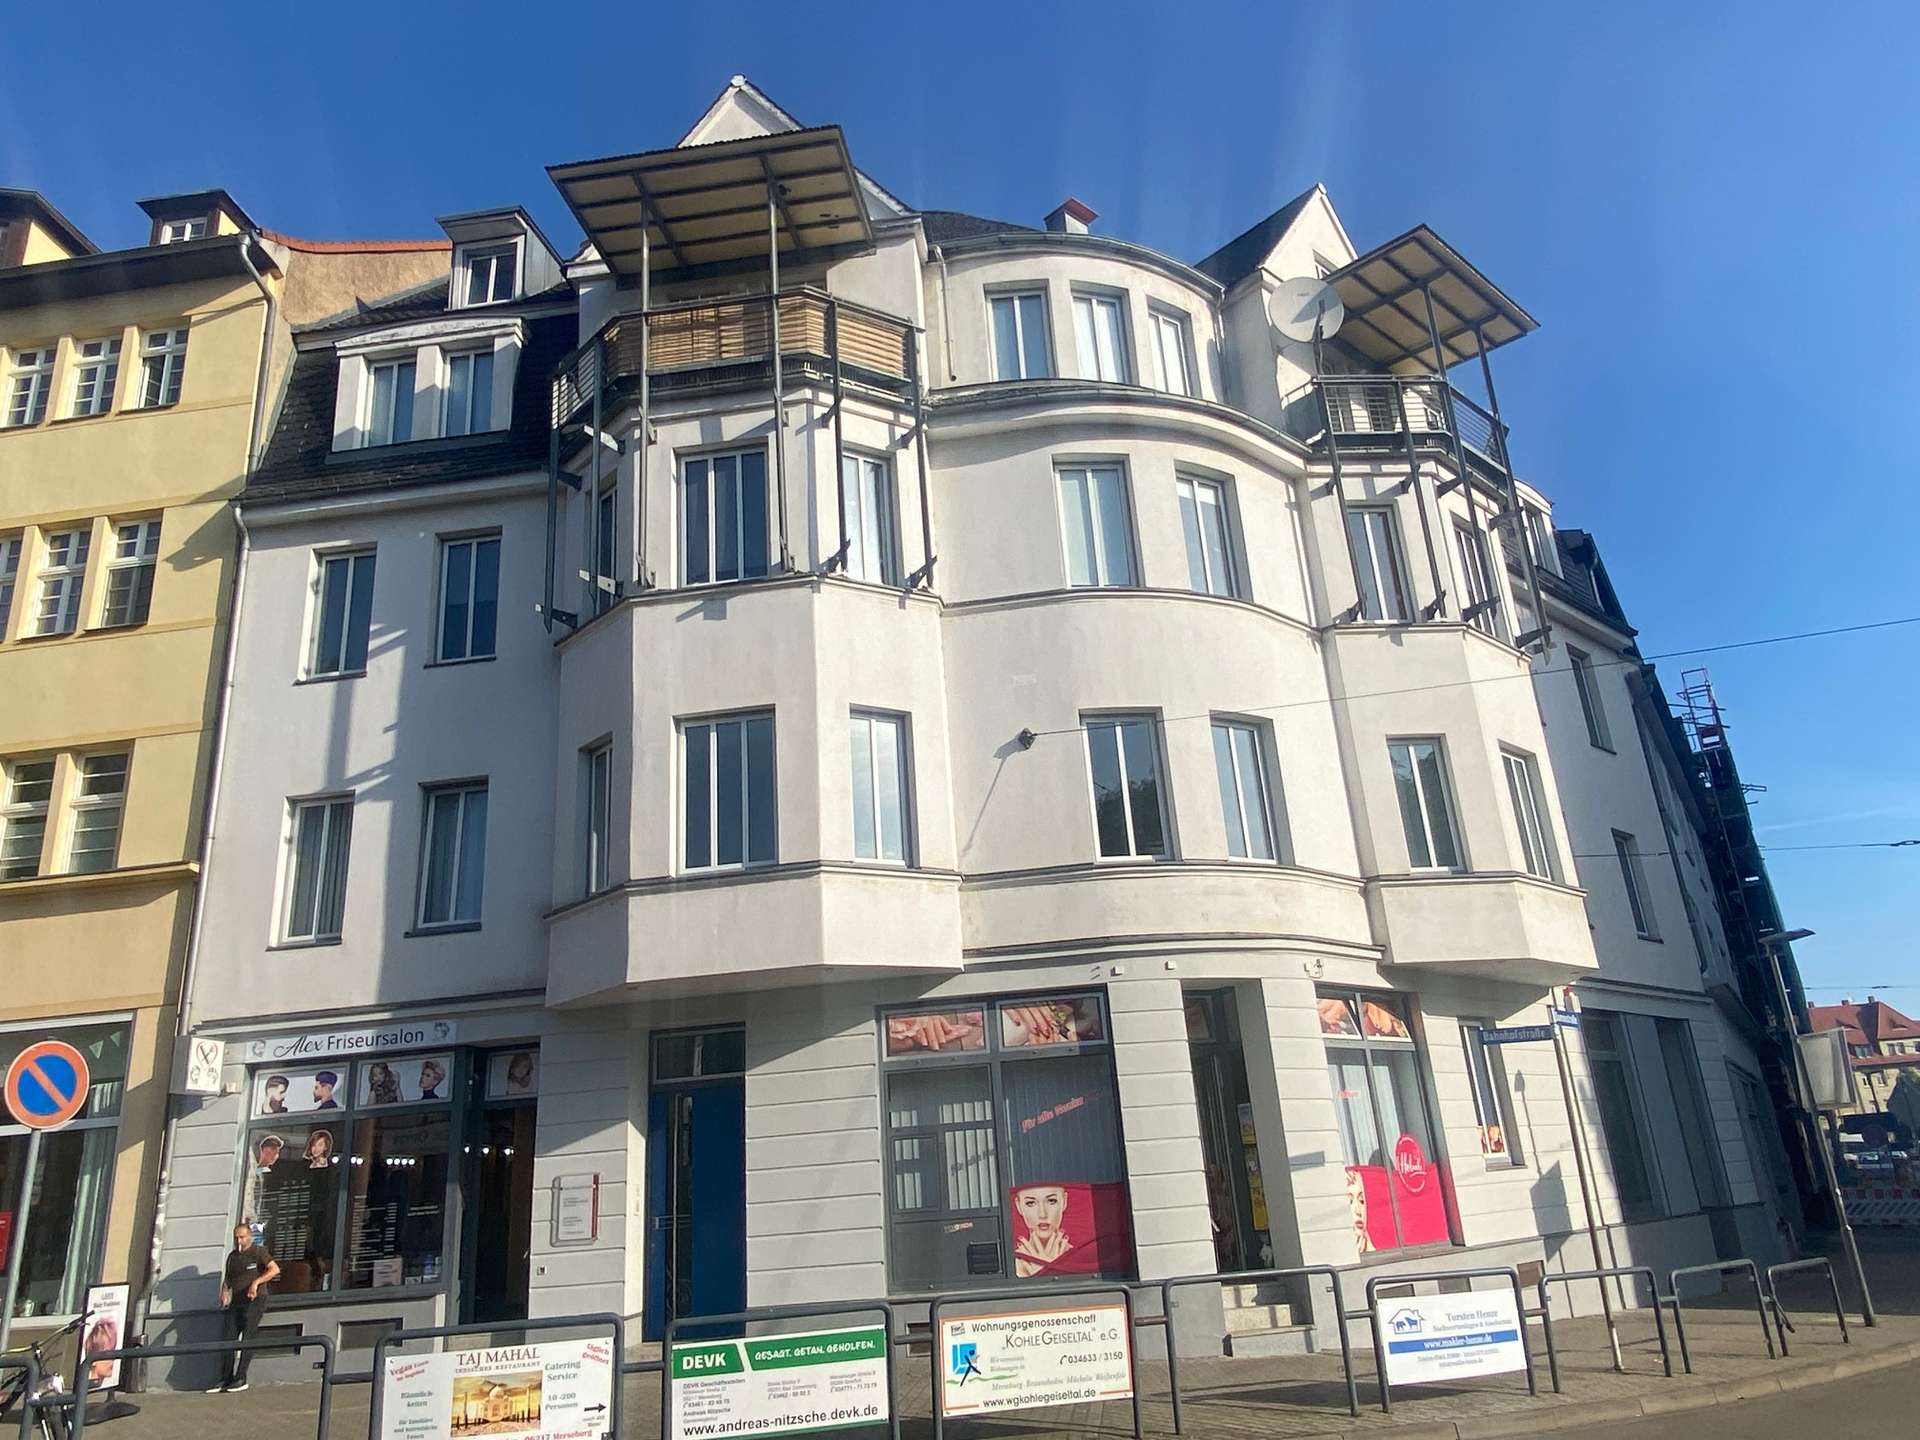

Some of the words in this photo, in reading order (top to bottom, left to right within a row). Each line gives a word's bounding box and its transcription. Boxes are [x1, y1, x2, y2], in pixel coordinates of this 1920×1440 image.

[1483, 1029, 1545, 1042] Bahnhofstraße
[273, 1035, 324, 1058] Alex
[327, 1029, 424, 1051] Friseursalon
[971, 1314, 1097, 1333] Wohnungsgenossenschaft
[1100, 1328, 1120, 1341] e.G.
[754, 1349, 792, 1361] GESAGT.
[794, 1346, 825, 1357] GETAN.
[827, 1340, 876, 1354] GEHOLFEN.
[456, 1351, 483, 1368] TAJ
[485, 1347, 541, 1363] MAHAL
[682, 1352, 726, 1370] DEVK
[1068, 1353, 1097, 1364] 034633
[1104, 1351, 1123, 1361] 3150
[495, 1360, 541, 1371] RESTAURANT
[545, 1360, 581, 1371] Catering
[547, 1371, 578, 1382] Service
[548, 1393, 558, 1401] 10
[983, 1388, 1097, 1407] www.wgkohlegeiseltal.de
[545, 1401, 578, 1411] Personen
[683, 1404, 879, 1437] www.andreas-nitzsche.devk.de
[553, 1429, 593, 1440] Merseburg
